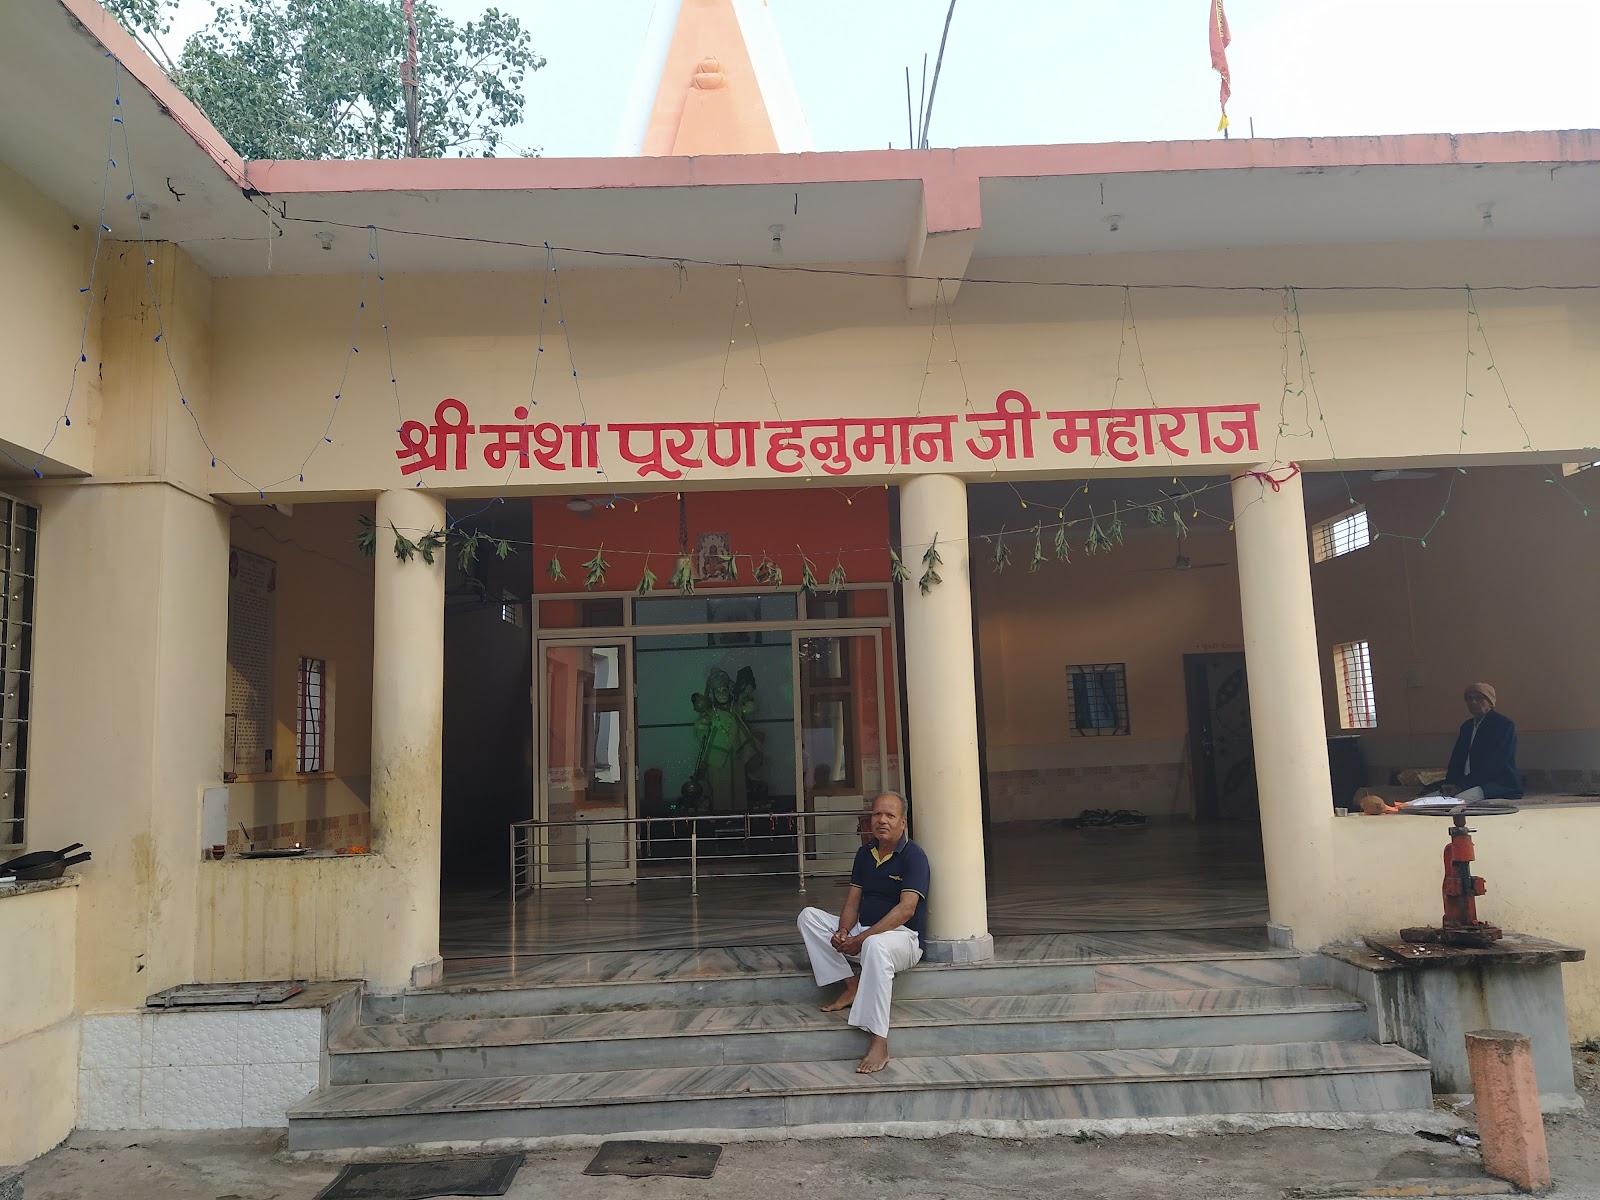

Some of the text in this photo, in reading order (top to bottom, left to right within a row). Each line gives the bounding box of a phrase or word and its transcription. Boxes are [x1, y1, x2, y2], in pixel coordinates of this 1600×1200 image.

[395, 389, 1261, 480] श्री मंशा पूरण हनुमान जी महाराज
